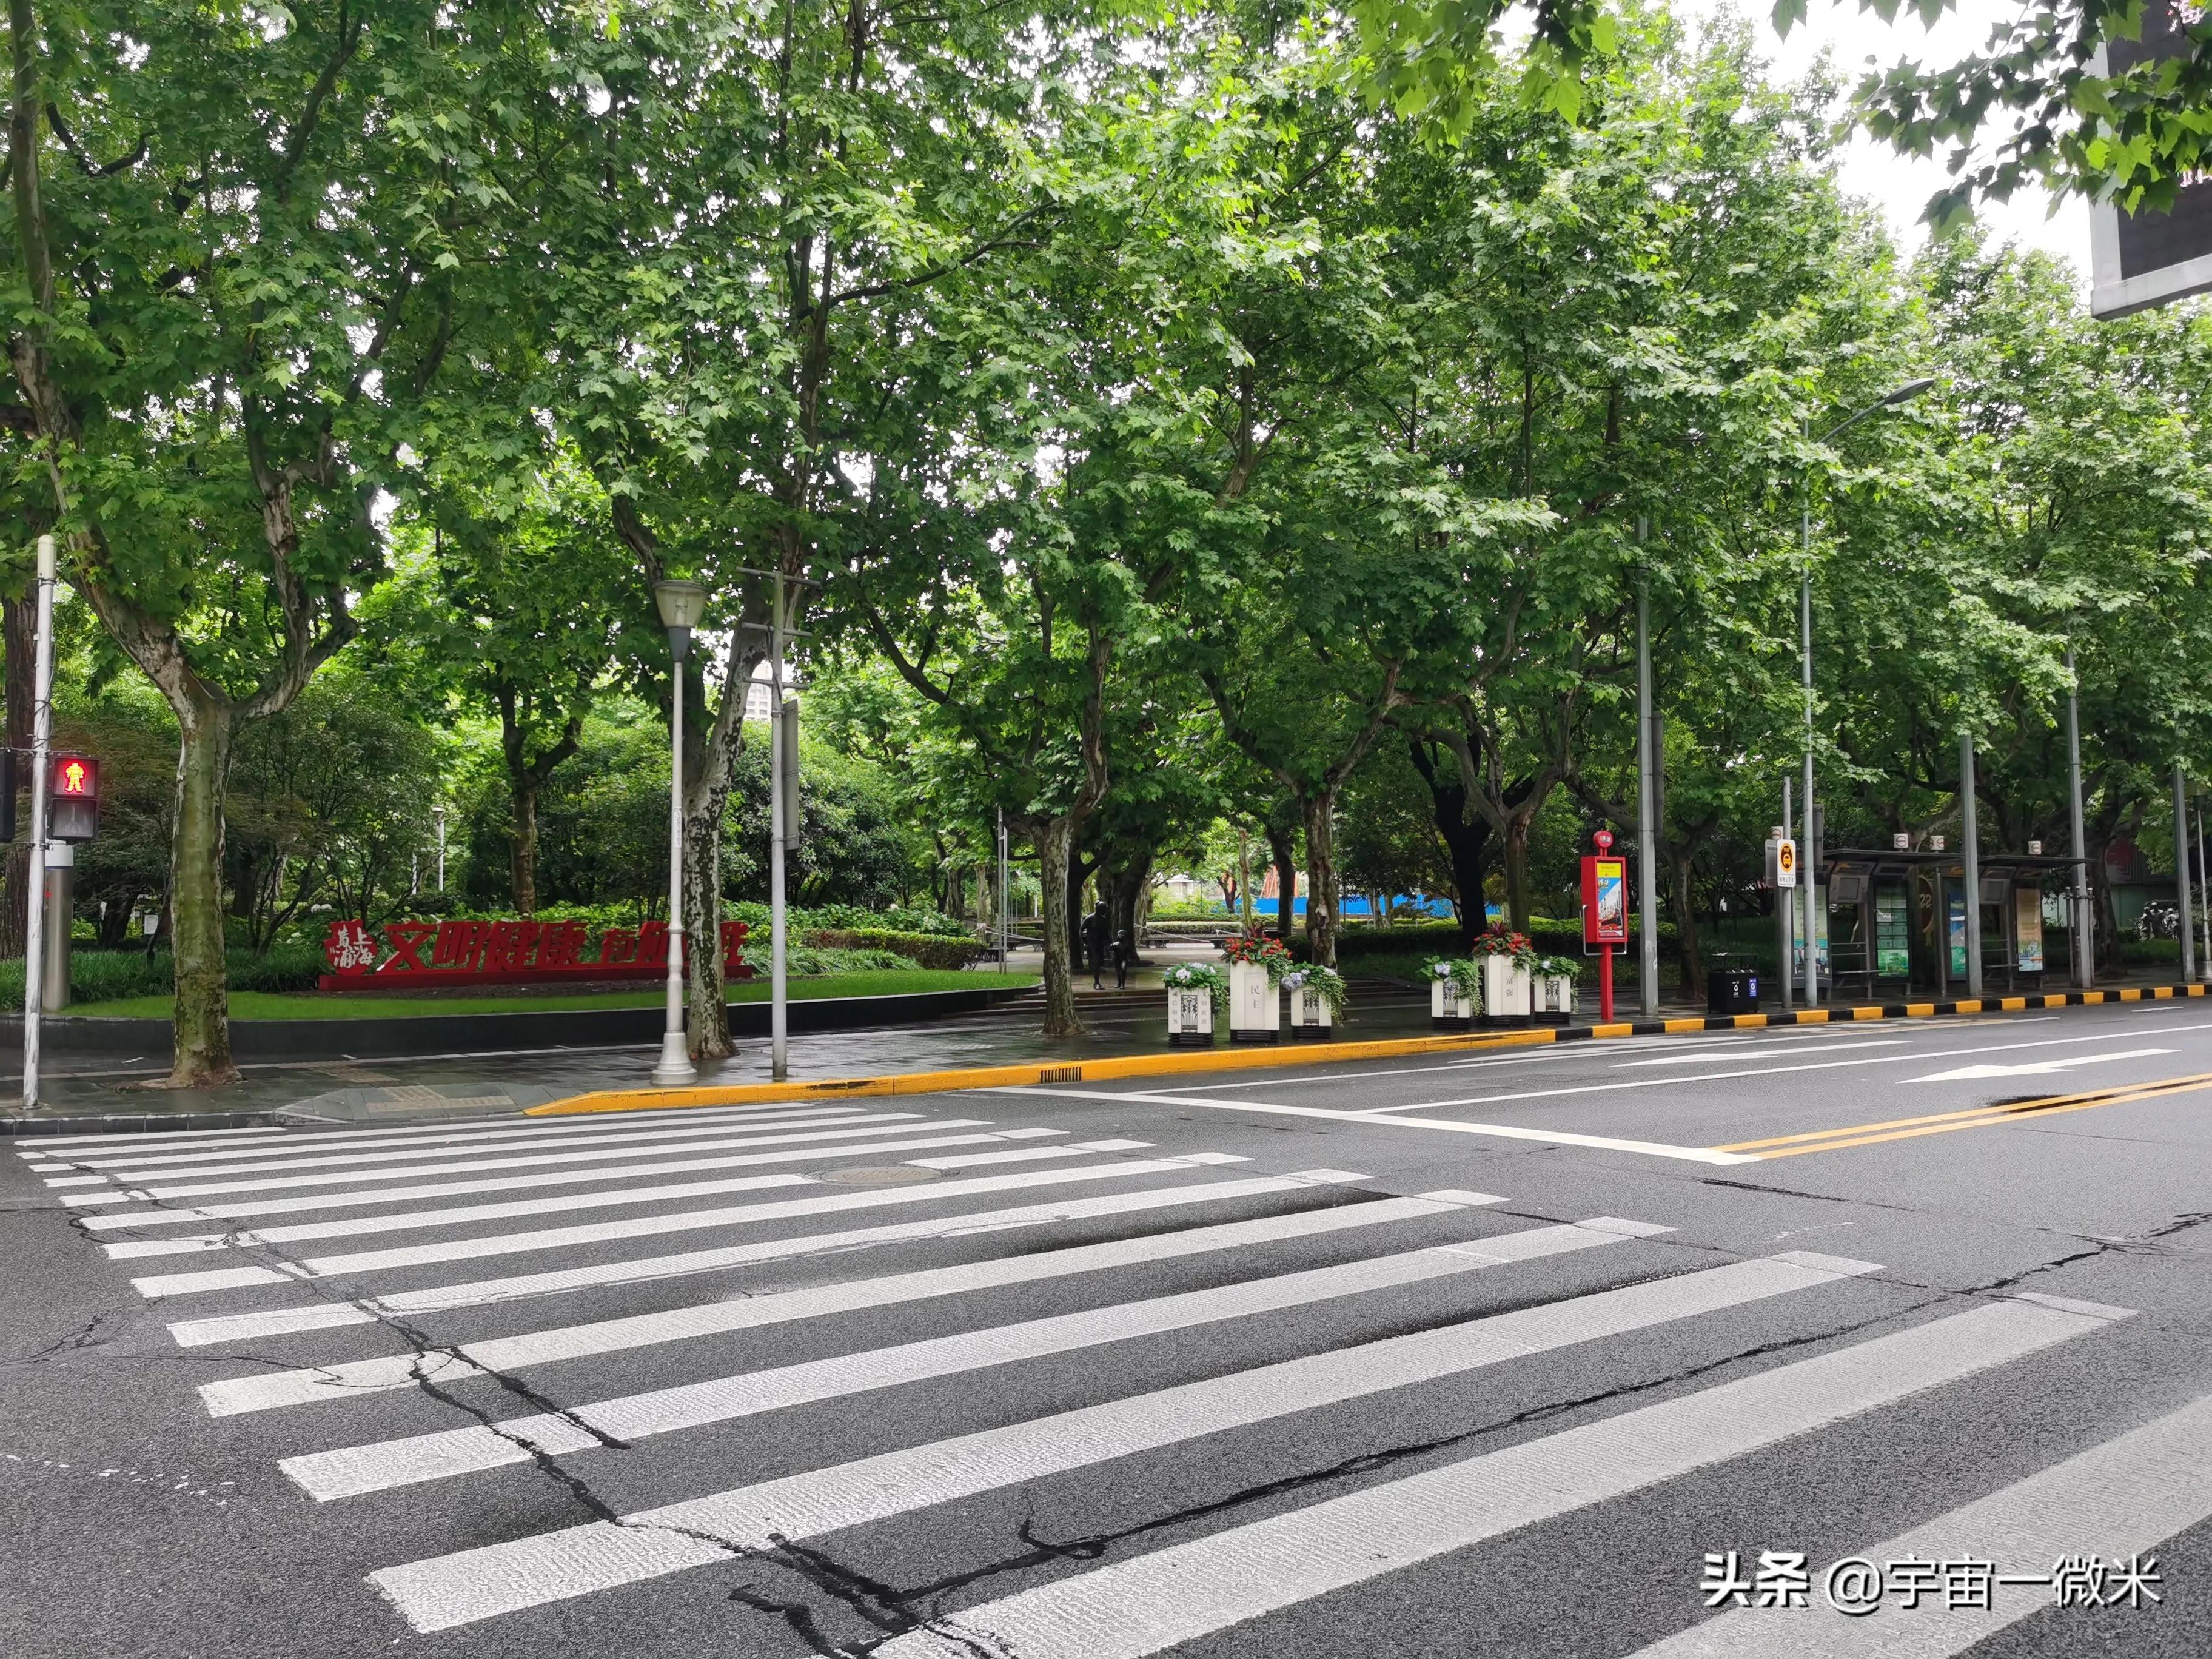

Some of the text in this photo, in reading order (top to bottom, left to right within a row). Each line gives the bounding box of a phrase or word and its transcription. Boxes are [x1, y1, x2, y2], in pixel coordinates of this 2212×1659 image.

[352, 927, 375, 965] 上海
[375, 920, 588, 972] 文明健康
[1251, 985, 1260, 1009] 民主
